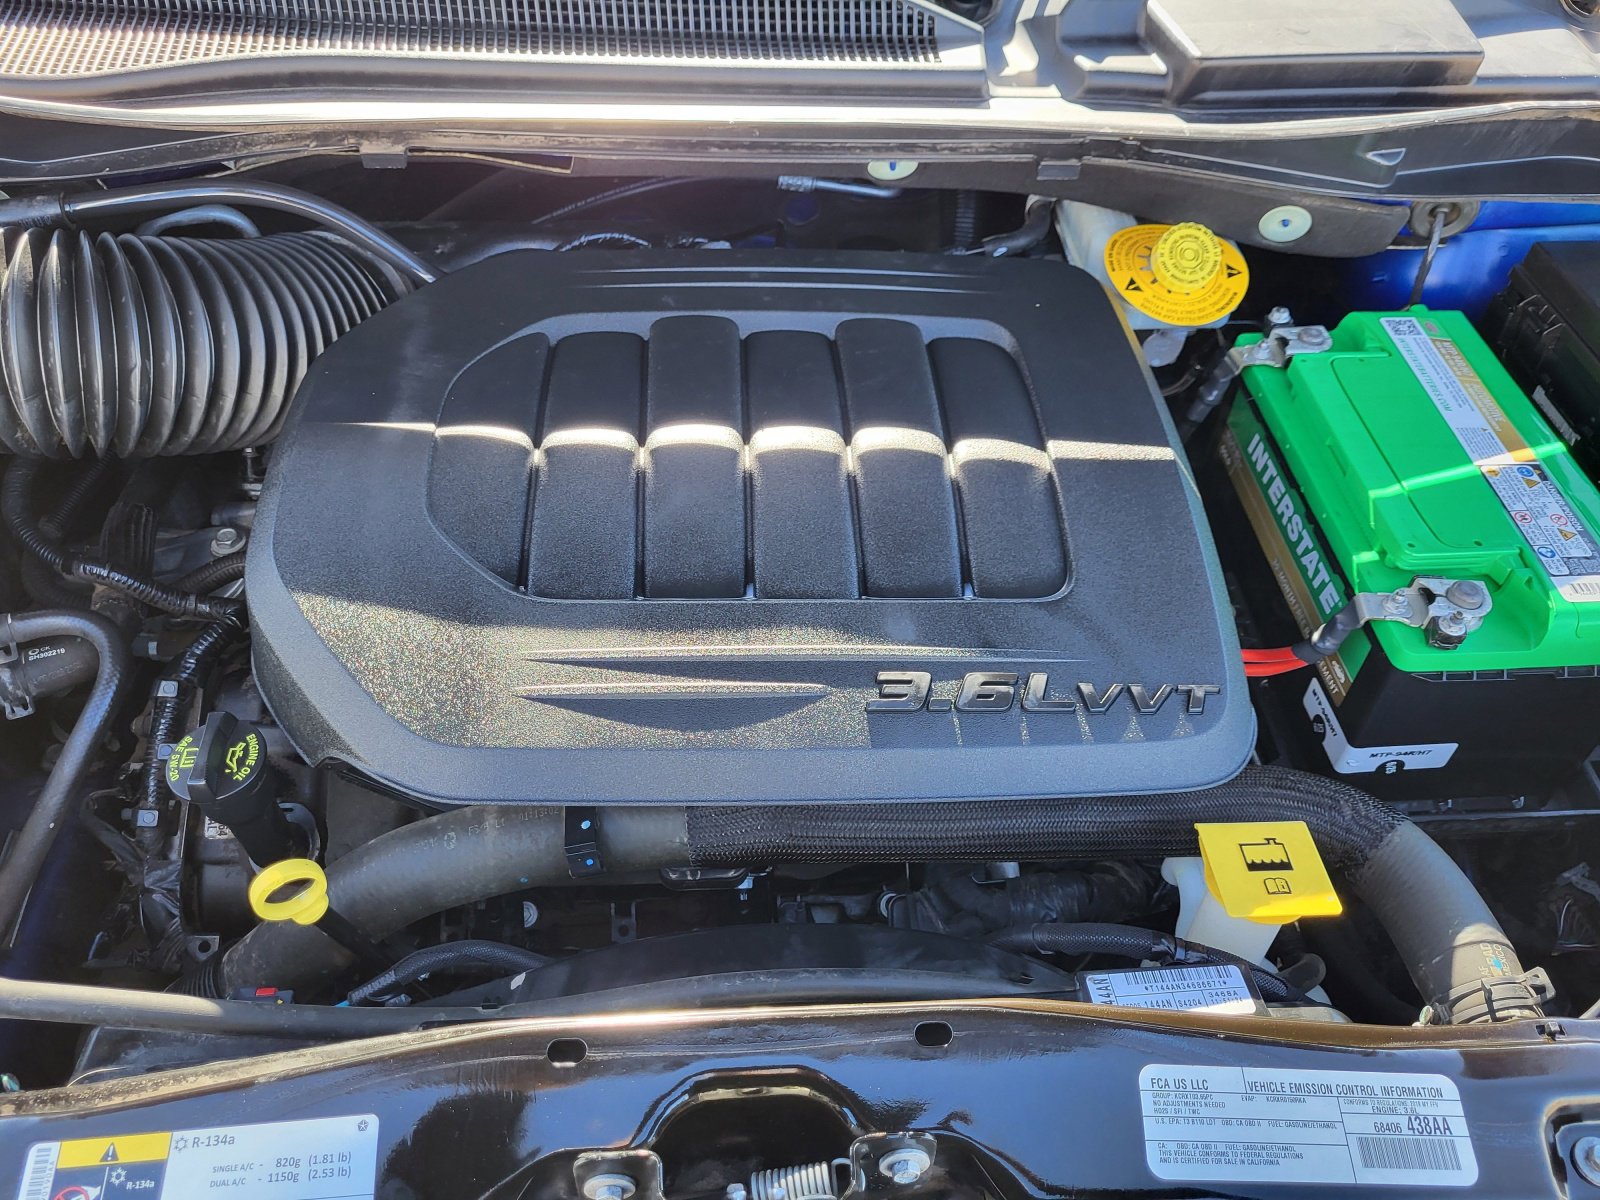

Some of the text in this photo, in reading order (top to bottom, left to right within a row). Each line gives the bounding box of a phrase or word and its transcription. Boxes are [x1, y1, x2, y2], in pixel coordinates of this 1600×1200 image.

[1246, 433, 1341, 615] INTERSTATE
[866, 671, 1222, 715] 3.6L VVT
[169, 735, 193, 782] SAE 5W-20
[232, 733, 260, 781] ENGINE OIL
[1150, 1077, 1209, 1091] FCA US LLC
[1247, 1081, 1444, 1098] VEHICLE EMISSION CONTROL INFORMATION
[1162, 1100, 1203, 1108] ADJUSTMENTS
[1372, 1105, 1420, 1115] ENGINE: 3.6L
[1374, 1115, 1453, 1136] 68406 438AA
[191, 1133, 236, 1149] R-134a
[1224, 1143, 1241, 1151] FUEL:
[212, 1163, 239, 1174] SINGLE
[239, 1161, 254, 1172] A/C
[275, 1156, 301, 1169] 820g
[308, 1153, 334, 1167] (1.81
[337, 1151, 352, 1164] lb)
[1159, 1156, 1172, 1164] AND
[1180, 1157, 1210, 1165] CERTIFIED
[1211, 1157, 1223, 1165] FOR
[1246, 1158, 1281, 1166] CALIFORNIA
[1198, 1150, 1230, 1158] CONFORMS
[1240, 1151, 1266, 1159] FEDERAL
[1265, 1151, 1304, 1160] REGULATIONS
[125, 1179, 156, 1190] R-134a
[209, 1178, 231, 1188] DUAL
[231, 1176, 247, 1187] A/C
[267, 1171, 300, 1183] 1150g
[308, 1167, 335, 1182] (2.53
[337, 1165, 352, 1179] lb)
